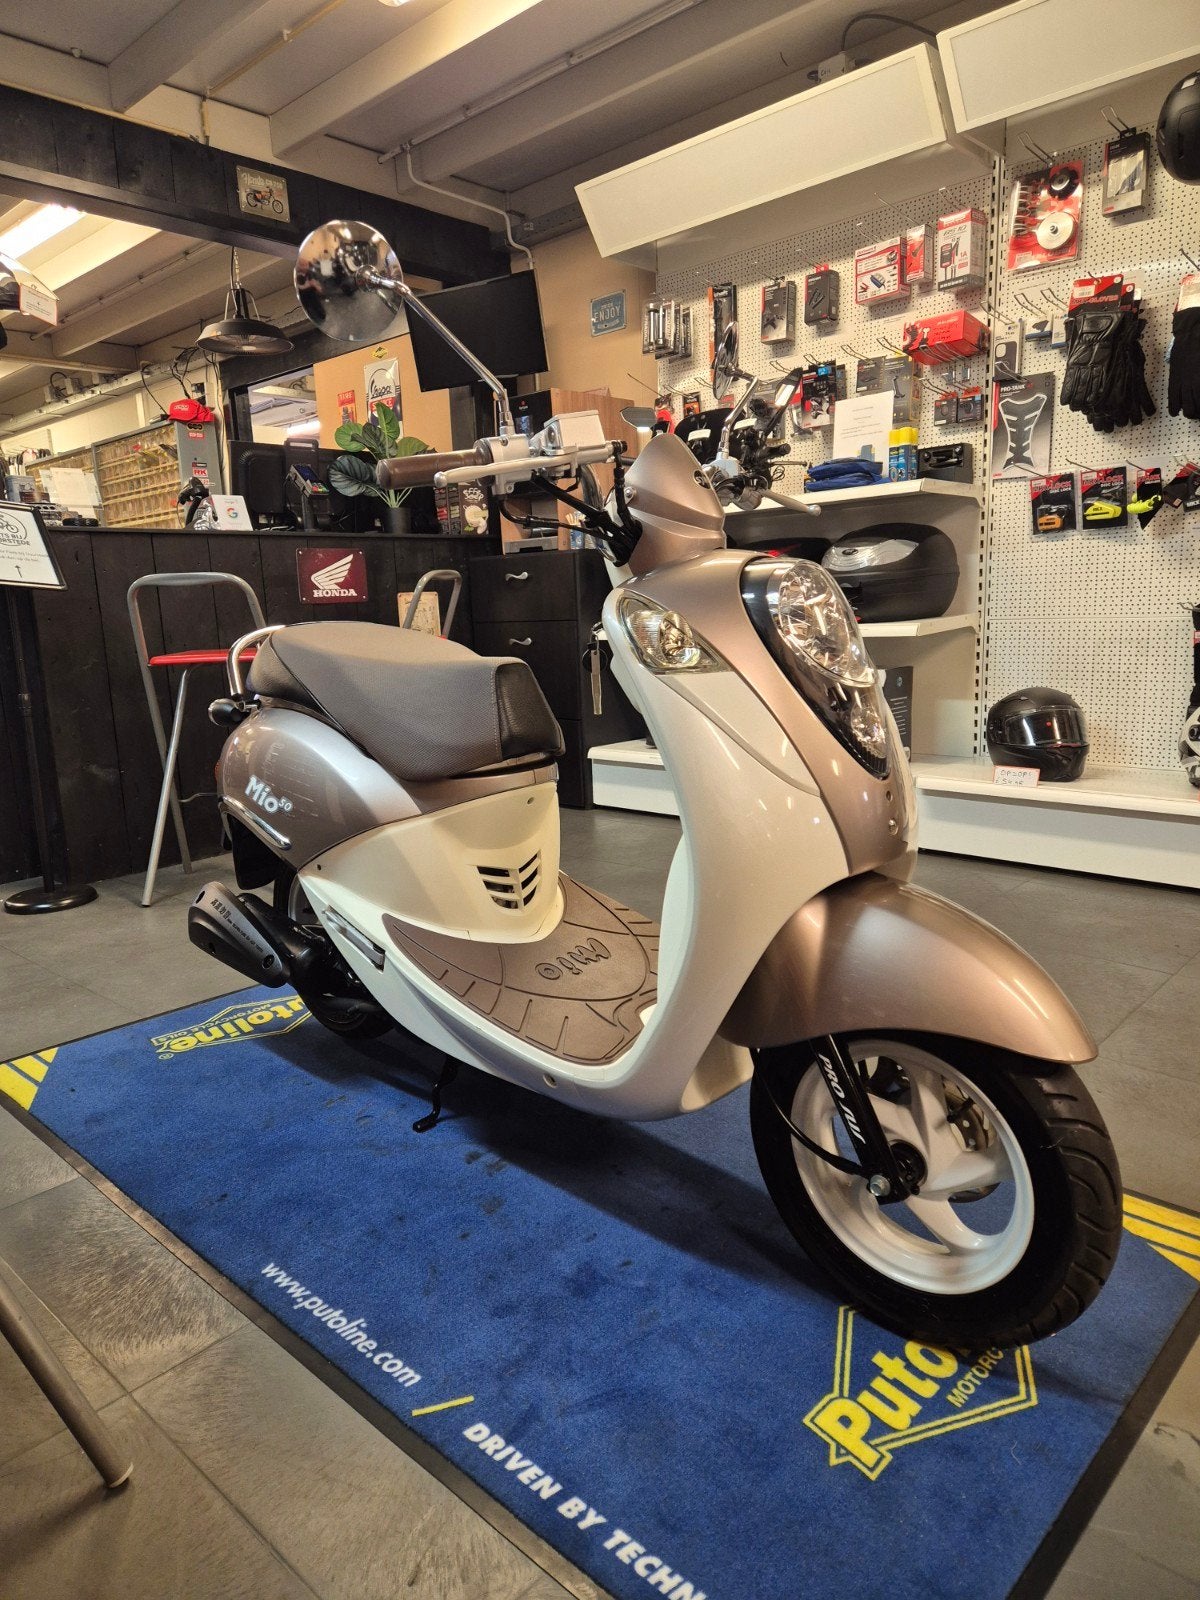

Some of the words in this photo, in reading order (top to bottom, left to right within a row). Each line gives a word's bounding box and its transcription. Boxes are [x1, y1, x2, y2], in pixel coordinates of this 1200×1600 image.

[593, 305, 622, 323] ENJOY
[312, 588, 358, 598] HONDA
[169, 996, 306, 1051] utoline
[195, 1004, 271, 1033] MOTORCYCLE
[818, 1052, 845, 1097] PRO
[261, 1262, 422, 1388] www.putoline.com
[462, 1422, 562, 1501] DRIVEN
[557, 1497, 607, 1532] BY
